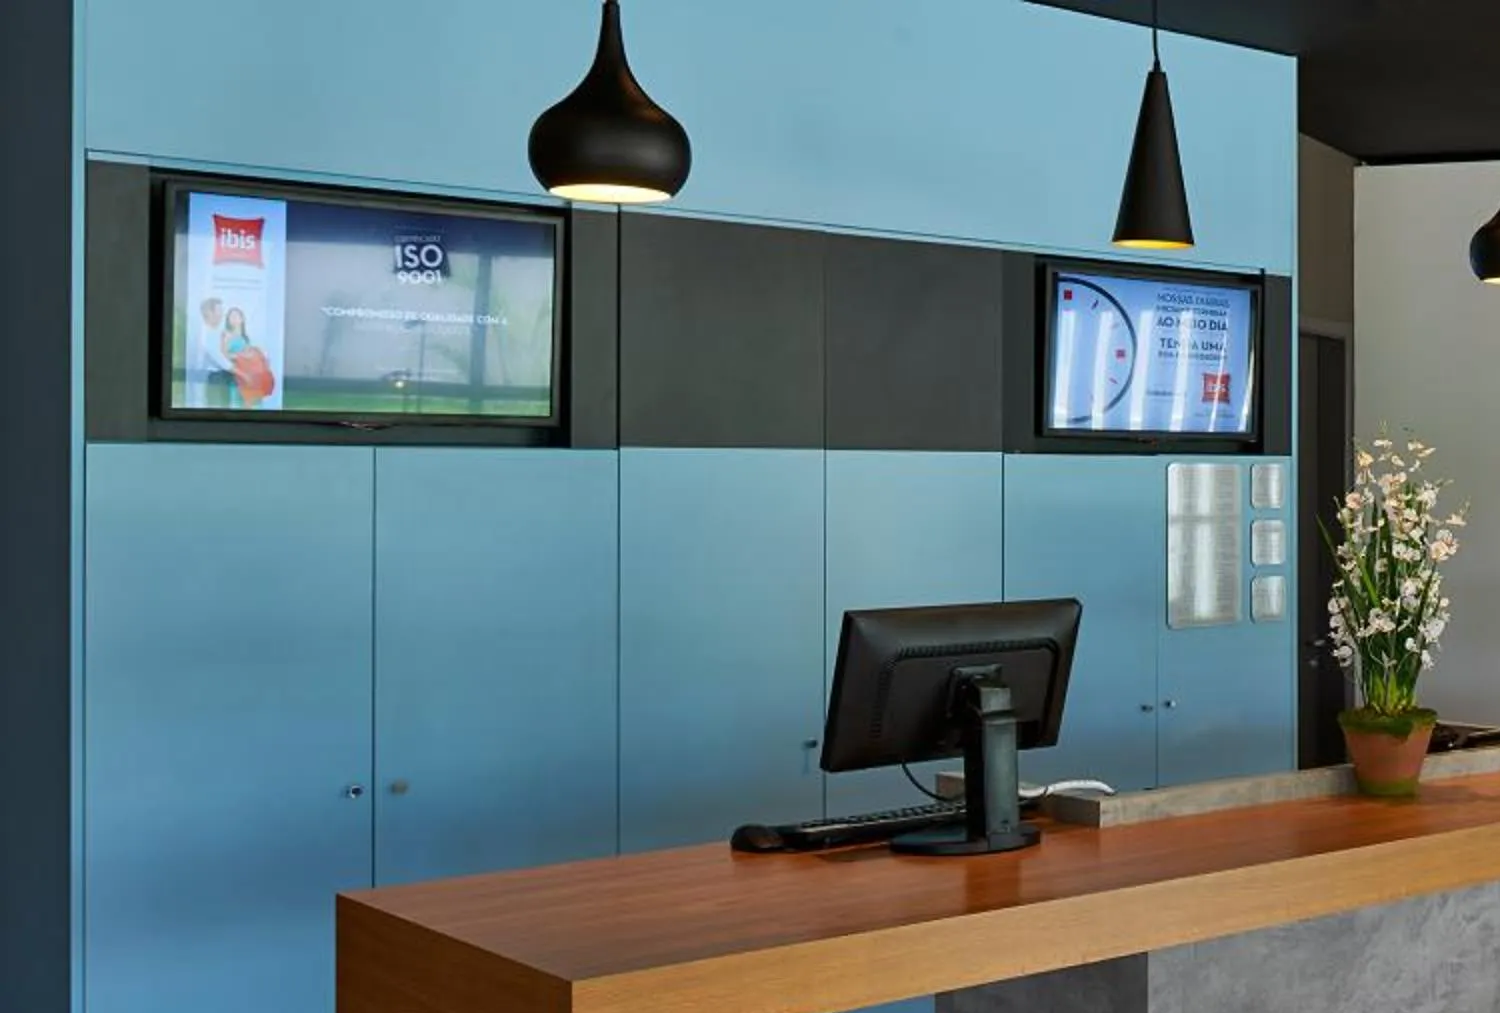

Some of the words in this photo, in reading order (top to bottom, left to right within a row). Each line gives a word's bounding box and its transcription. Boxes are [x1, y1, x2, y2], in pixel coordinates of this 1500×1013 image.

[220, 227, 256, 249] ibis
[395, 244, 443, 268] ISO
[397, 269, 441, 284] 9001
[1175, 318, 1207, 330] MIO
[1209, 320, 1228, 331] DIA
[1160, 337, 1199, 349] TENA
